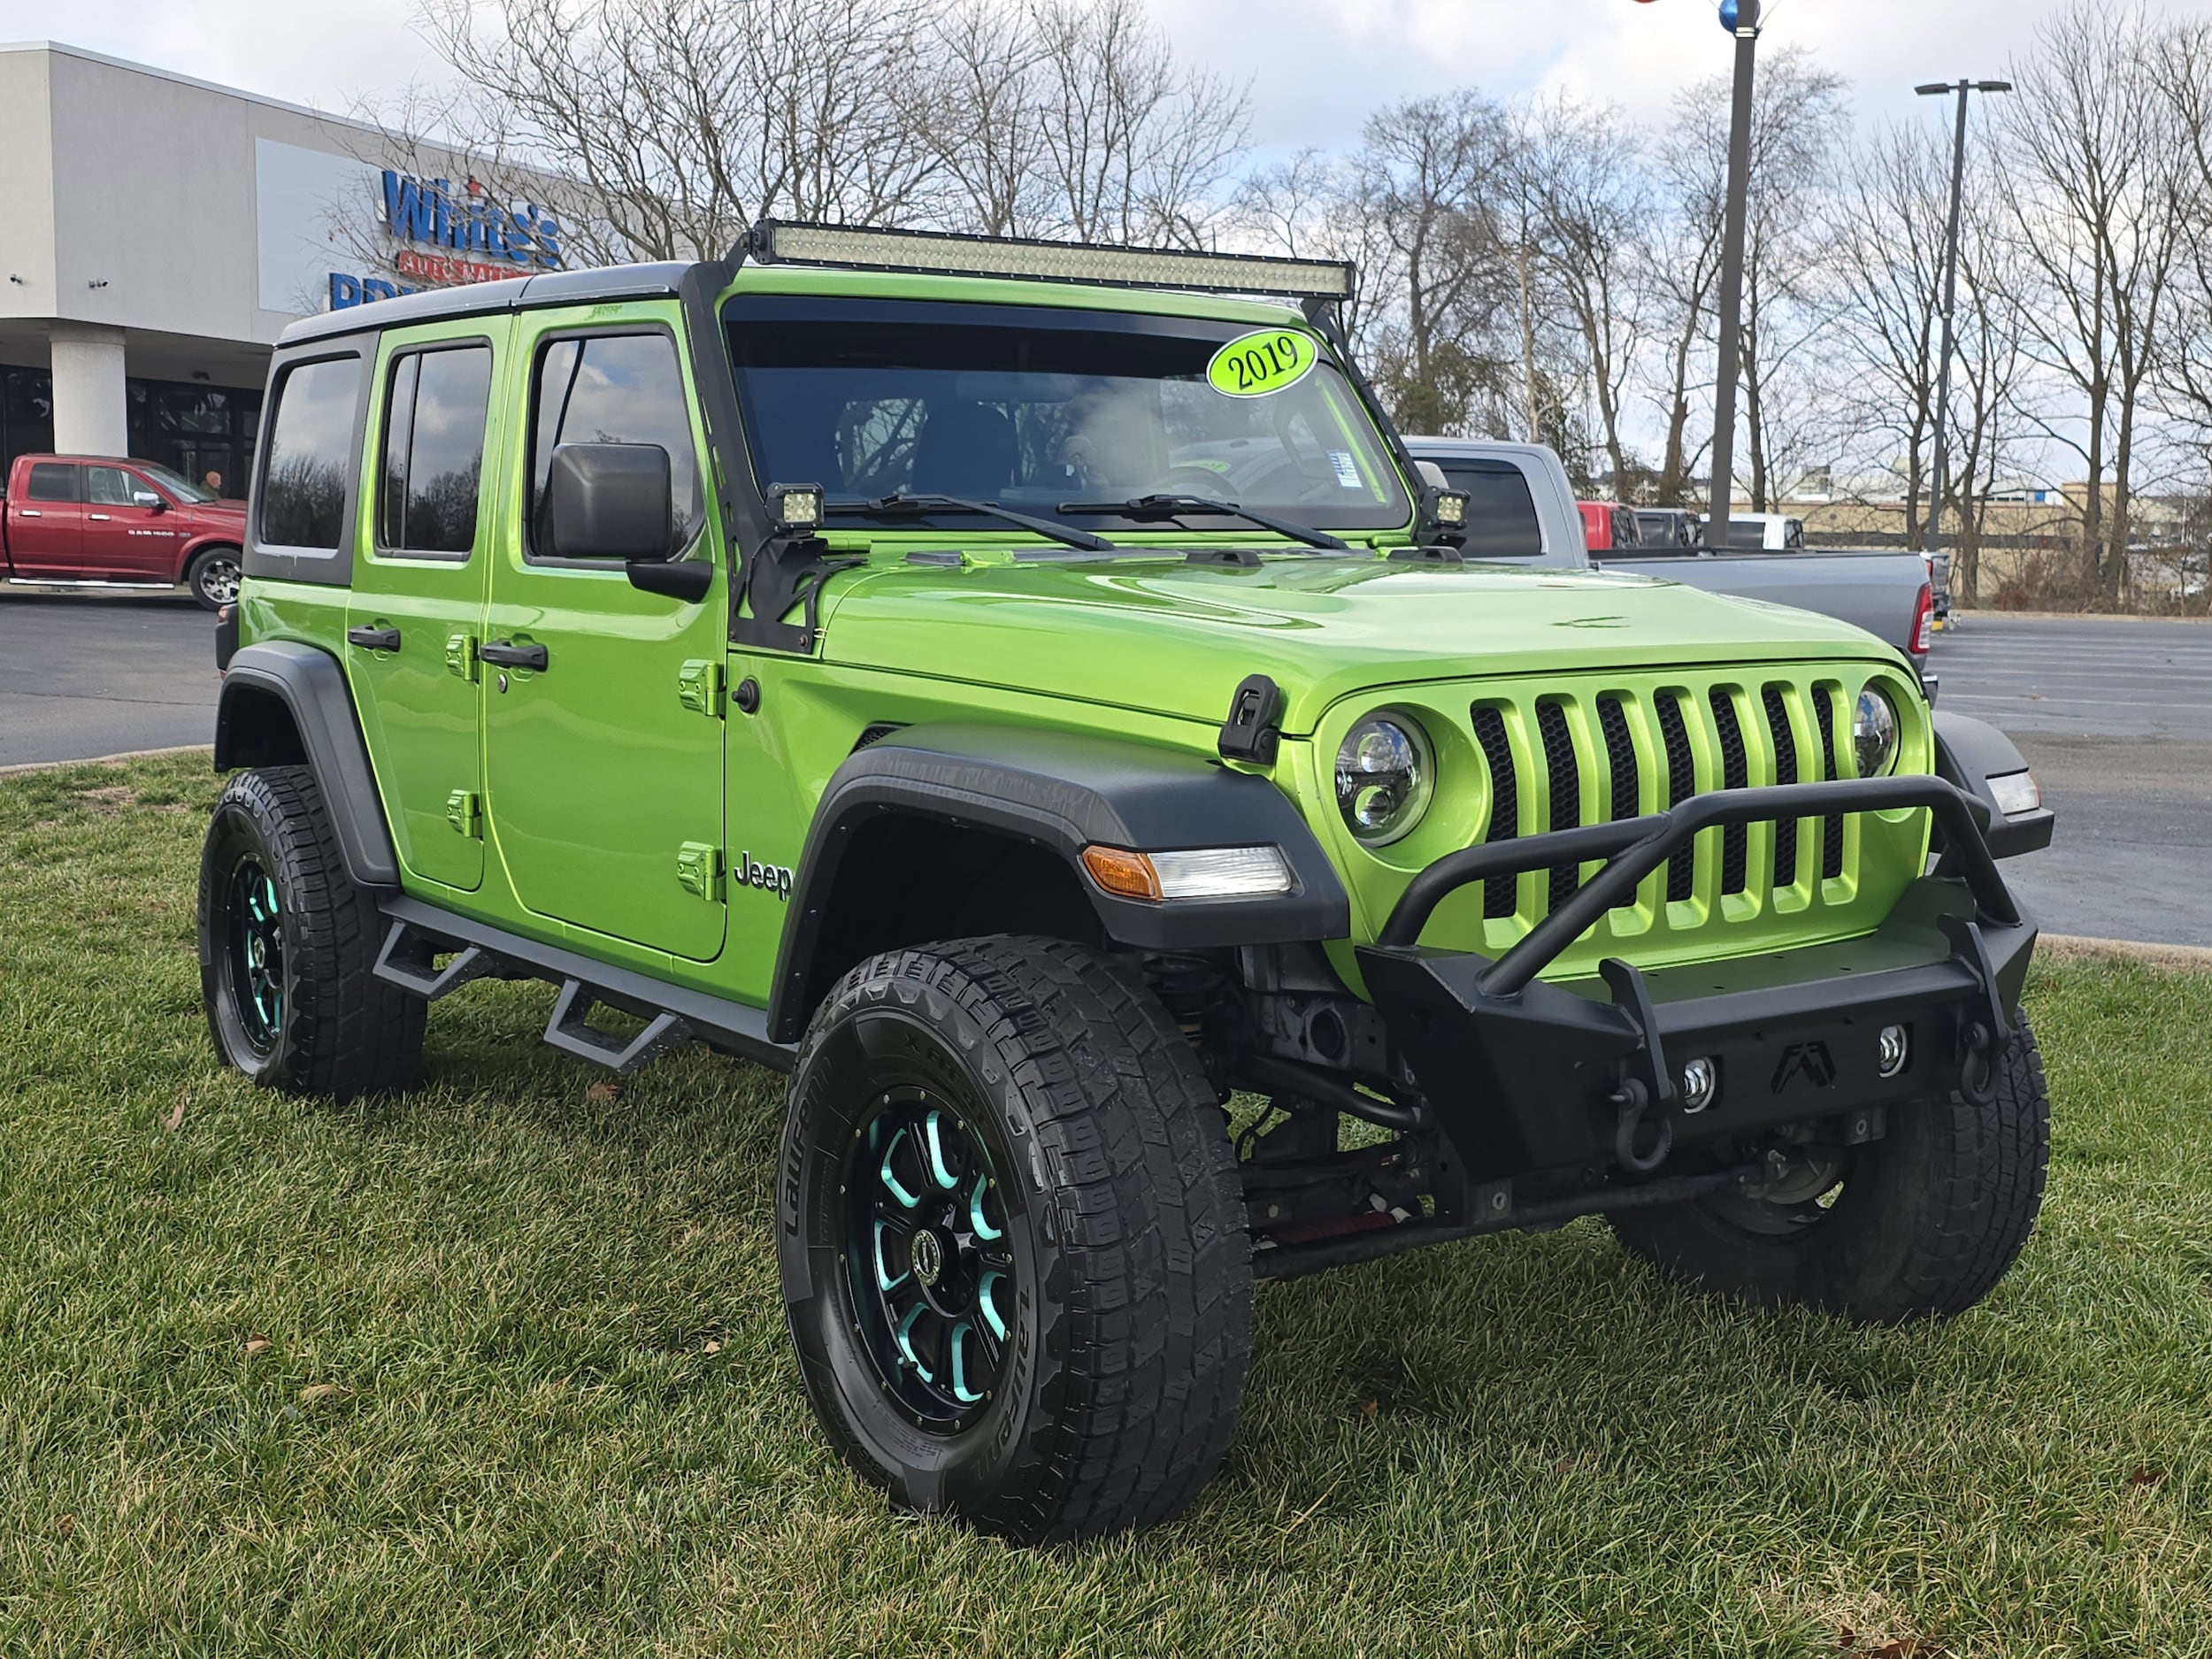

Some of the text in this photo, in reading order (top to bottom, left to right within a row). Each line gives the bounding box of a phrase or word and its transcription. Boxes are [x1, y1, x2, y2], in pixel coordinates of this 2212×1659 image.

[382, 171, 559, 265] White's
[1228, 336, 1298, 390] 2019
[733, 850, 795, 902] Jeep
